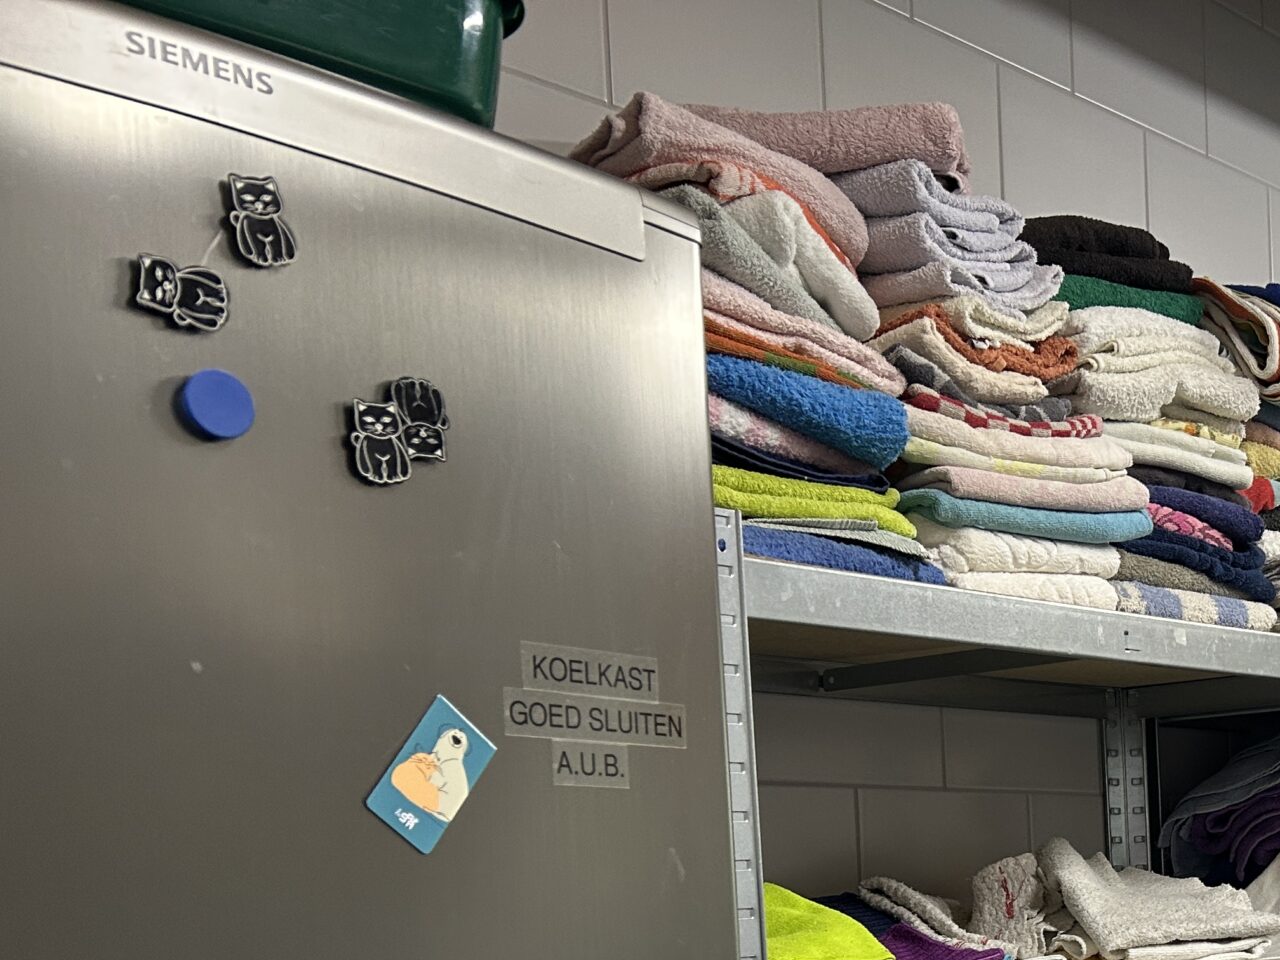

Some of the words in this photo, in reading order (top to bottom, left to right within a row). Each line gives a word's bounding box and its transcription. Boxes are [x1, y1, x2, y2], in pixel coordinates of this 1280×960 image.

[125, 30, 274, 95] SIEMENS
[531, 654, 656, 692] KOELKAST
[509, 700, 582, 730] GOED
[588, 708, 684, 738] SLUITEN
[556, 750, 626, 779] A.U.B.
